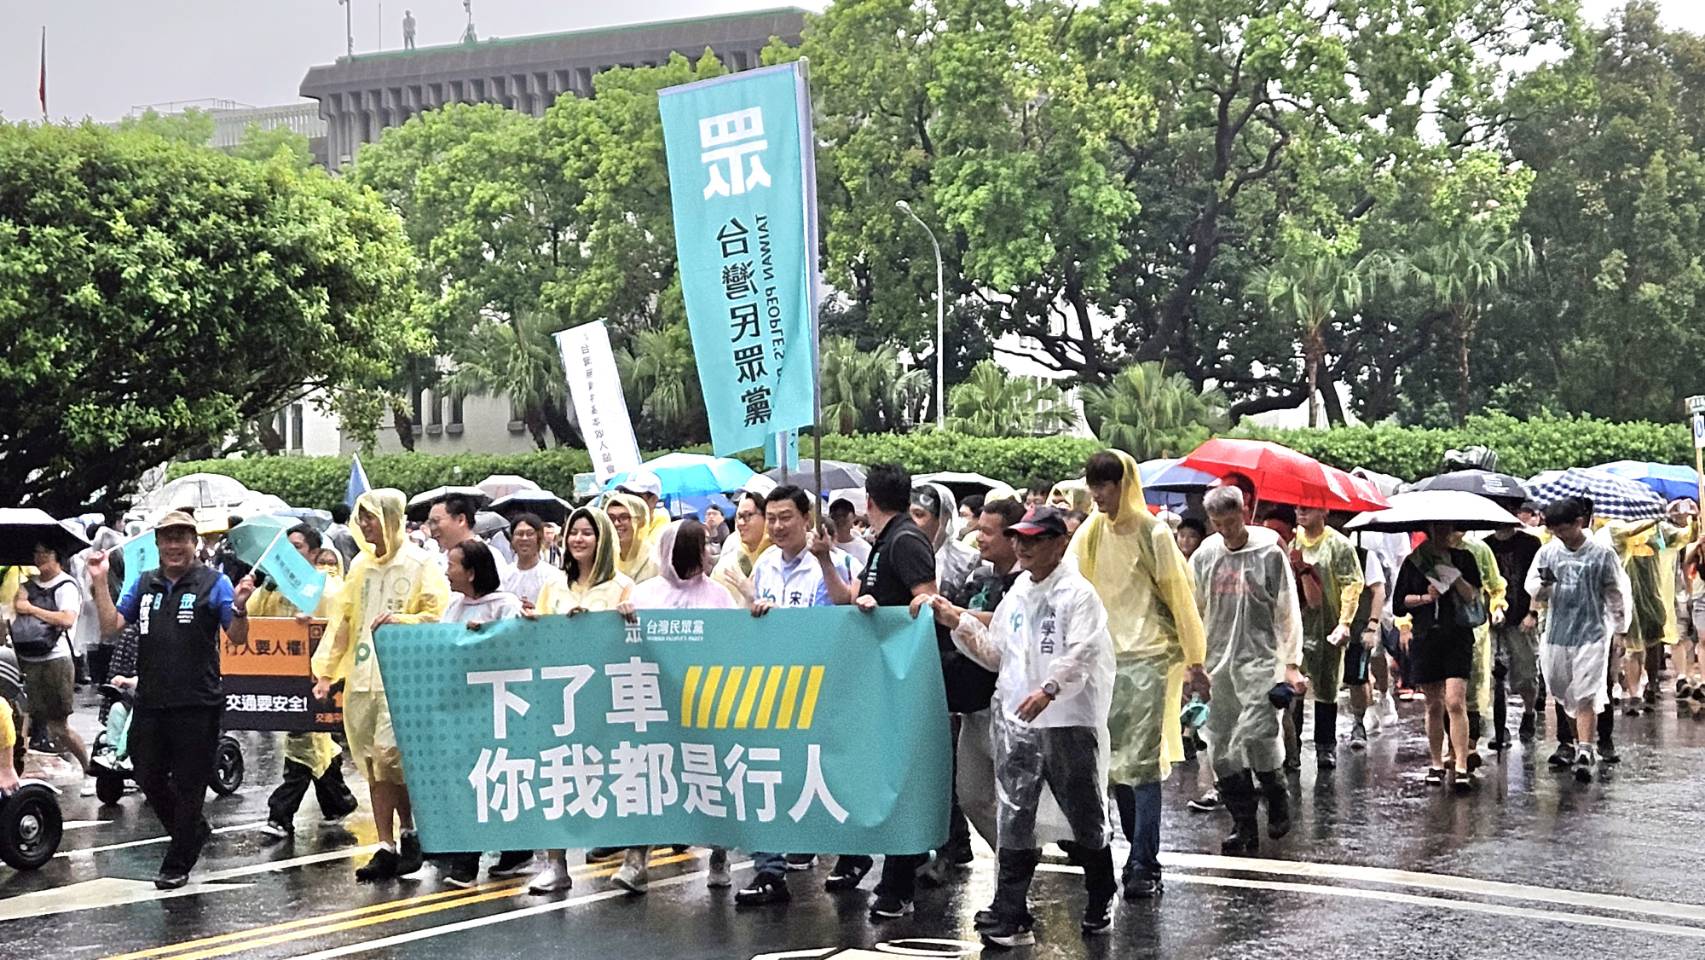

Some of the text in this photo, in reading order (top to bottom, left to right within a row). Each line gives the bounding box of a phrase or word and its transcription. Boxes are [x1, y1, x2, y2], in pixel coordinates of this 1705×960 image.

[646, 619, 705, 635] 台灣民眾黨
[225, 694, 308, 712] 交通要安全!
[466, 656, 669, 739] 下了車
[468, 741, 850, 824] 你我都是行人
